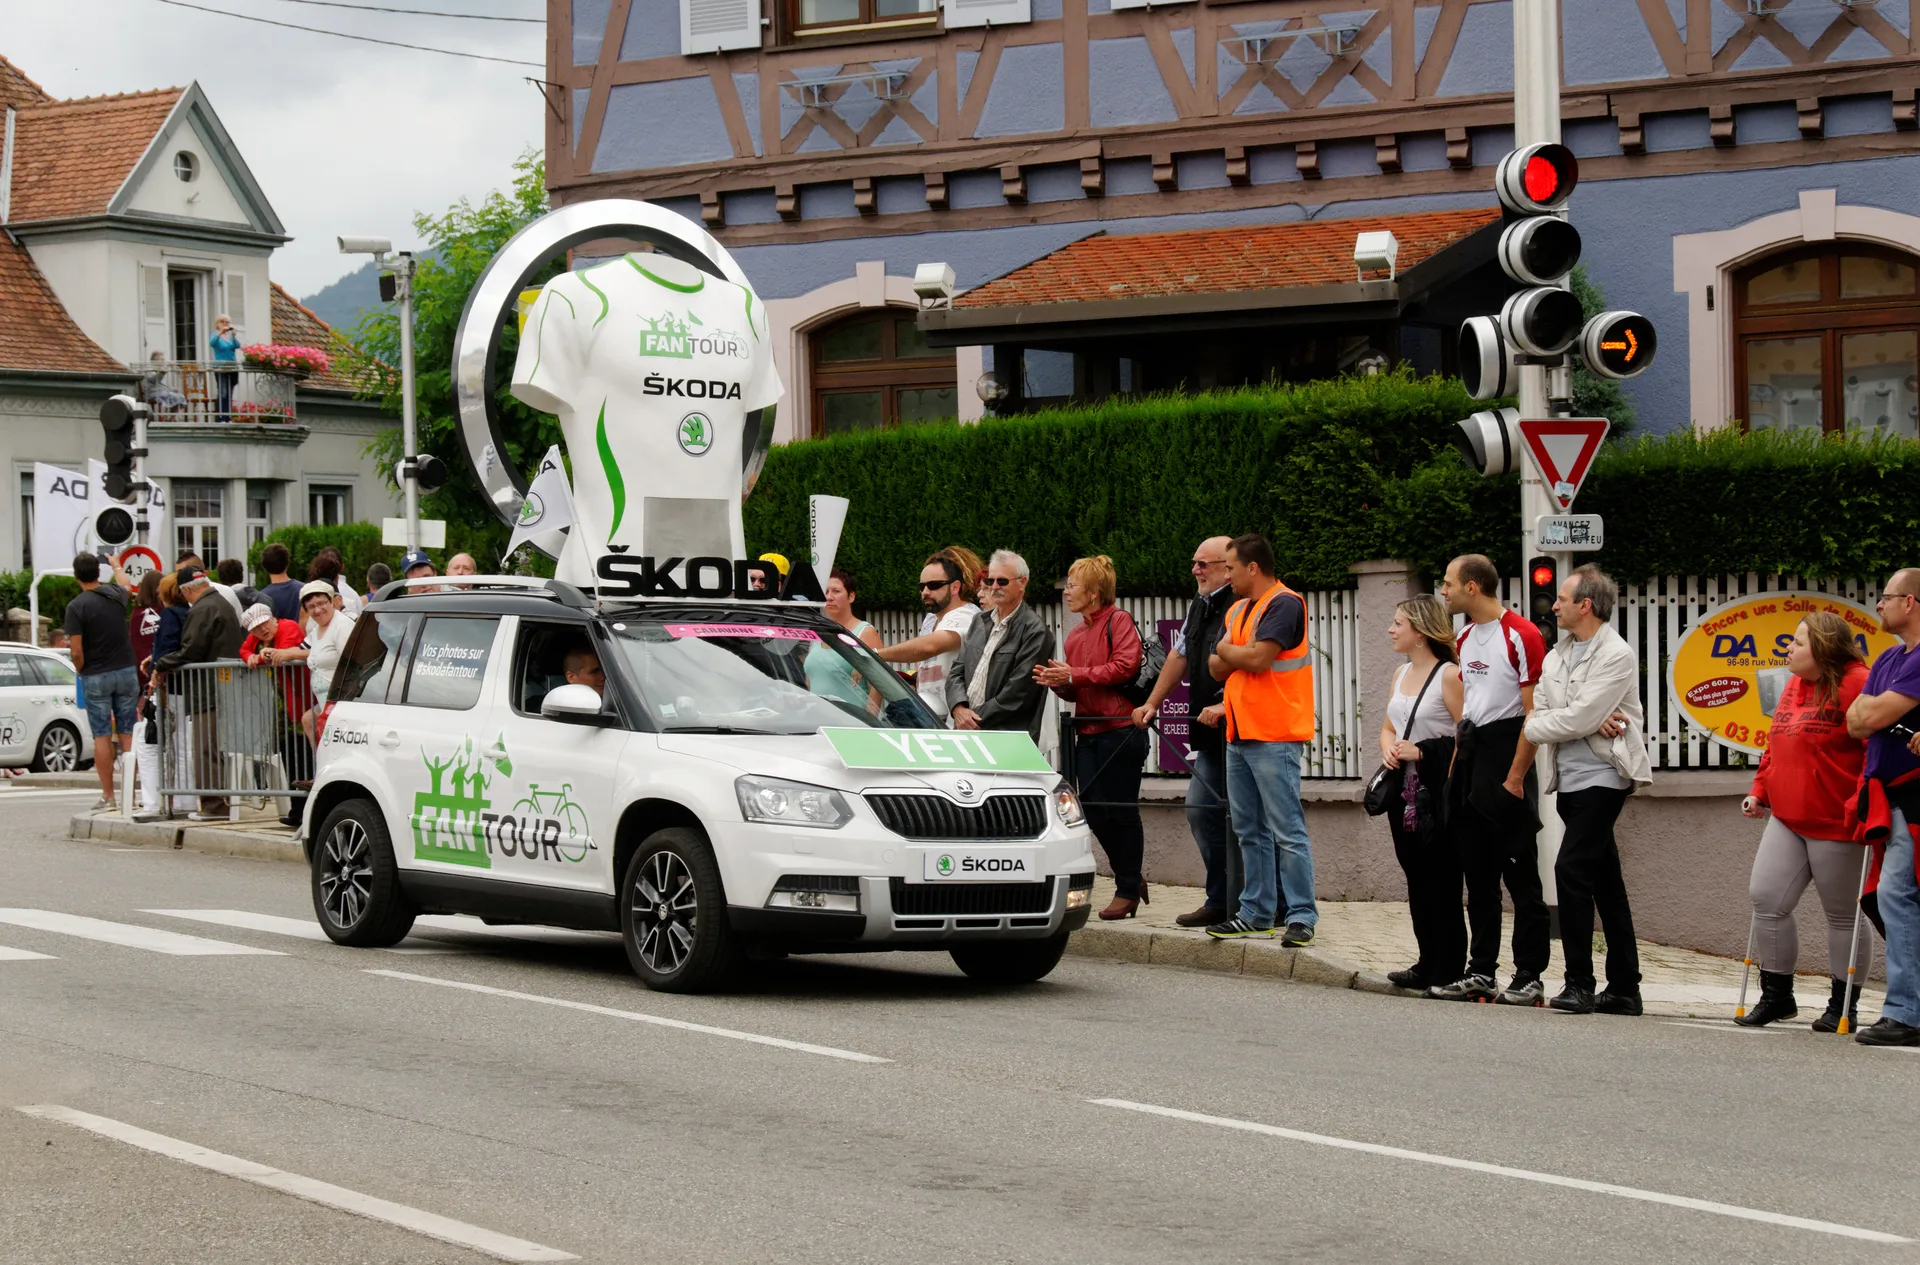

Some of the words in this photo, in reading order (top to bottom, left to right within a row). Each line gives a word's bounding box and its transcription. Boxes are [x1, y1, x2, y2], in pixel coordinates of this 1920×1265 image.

[643, 372, 741, 400] ŠKODA
[597, 545, 827, 602] ŠKODA
[1702, 610, 1748, 636] Encore
[1753, 602, 1776, 616] une
[1783, 599, 1816, 612] Salle
[1844, 610, 1877, 635] Bains
[422, 643, 437, 657] Vos
[437, 643, 468, 660] photos
[468, 648, 484, 659] sur
[1711, 634, 1757, 658] DA
[416, 661, 478, 678] #skodafantour
[1727, 658, 1750, 667] 96-98
[1752, 659, 1765, 667] rue
[1768, 658, 1790, 667] Vaub
[1687, 684, 1710, 698] Expo
[1711, 679, 1728, 687] 600
[1712, 691, 1721, 699] plus
[1722, 687, 1740, 696] grandes
[1163, 699, 1190, 718] Espac
[332, 727, 369, 745] ŠKODA
[1725, 721, 1749, 742] 03
[1754, 730, 1770, 747] 8
[877, 733, 997, 764] YETI
[962, 856, 1025, 872] ŠKODA
